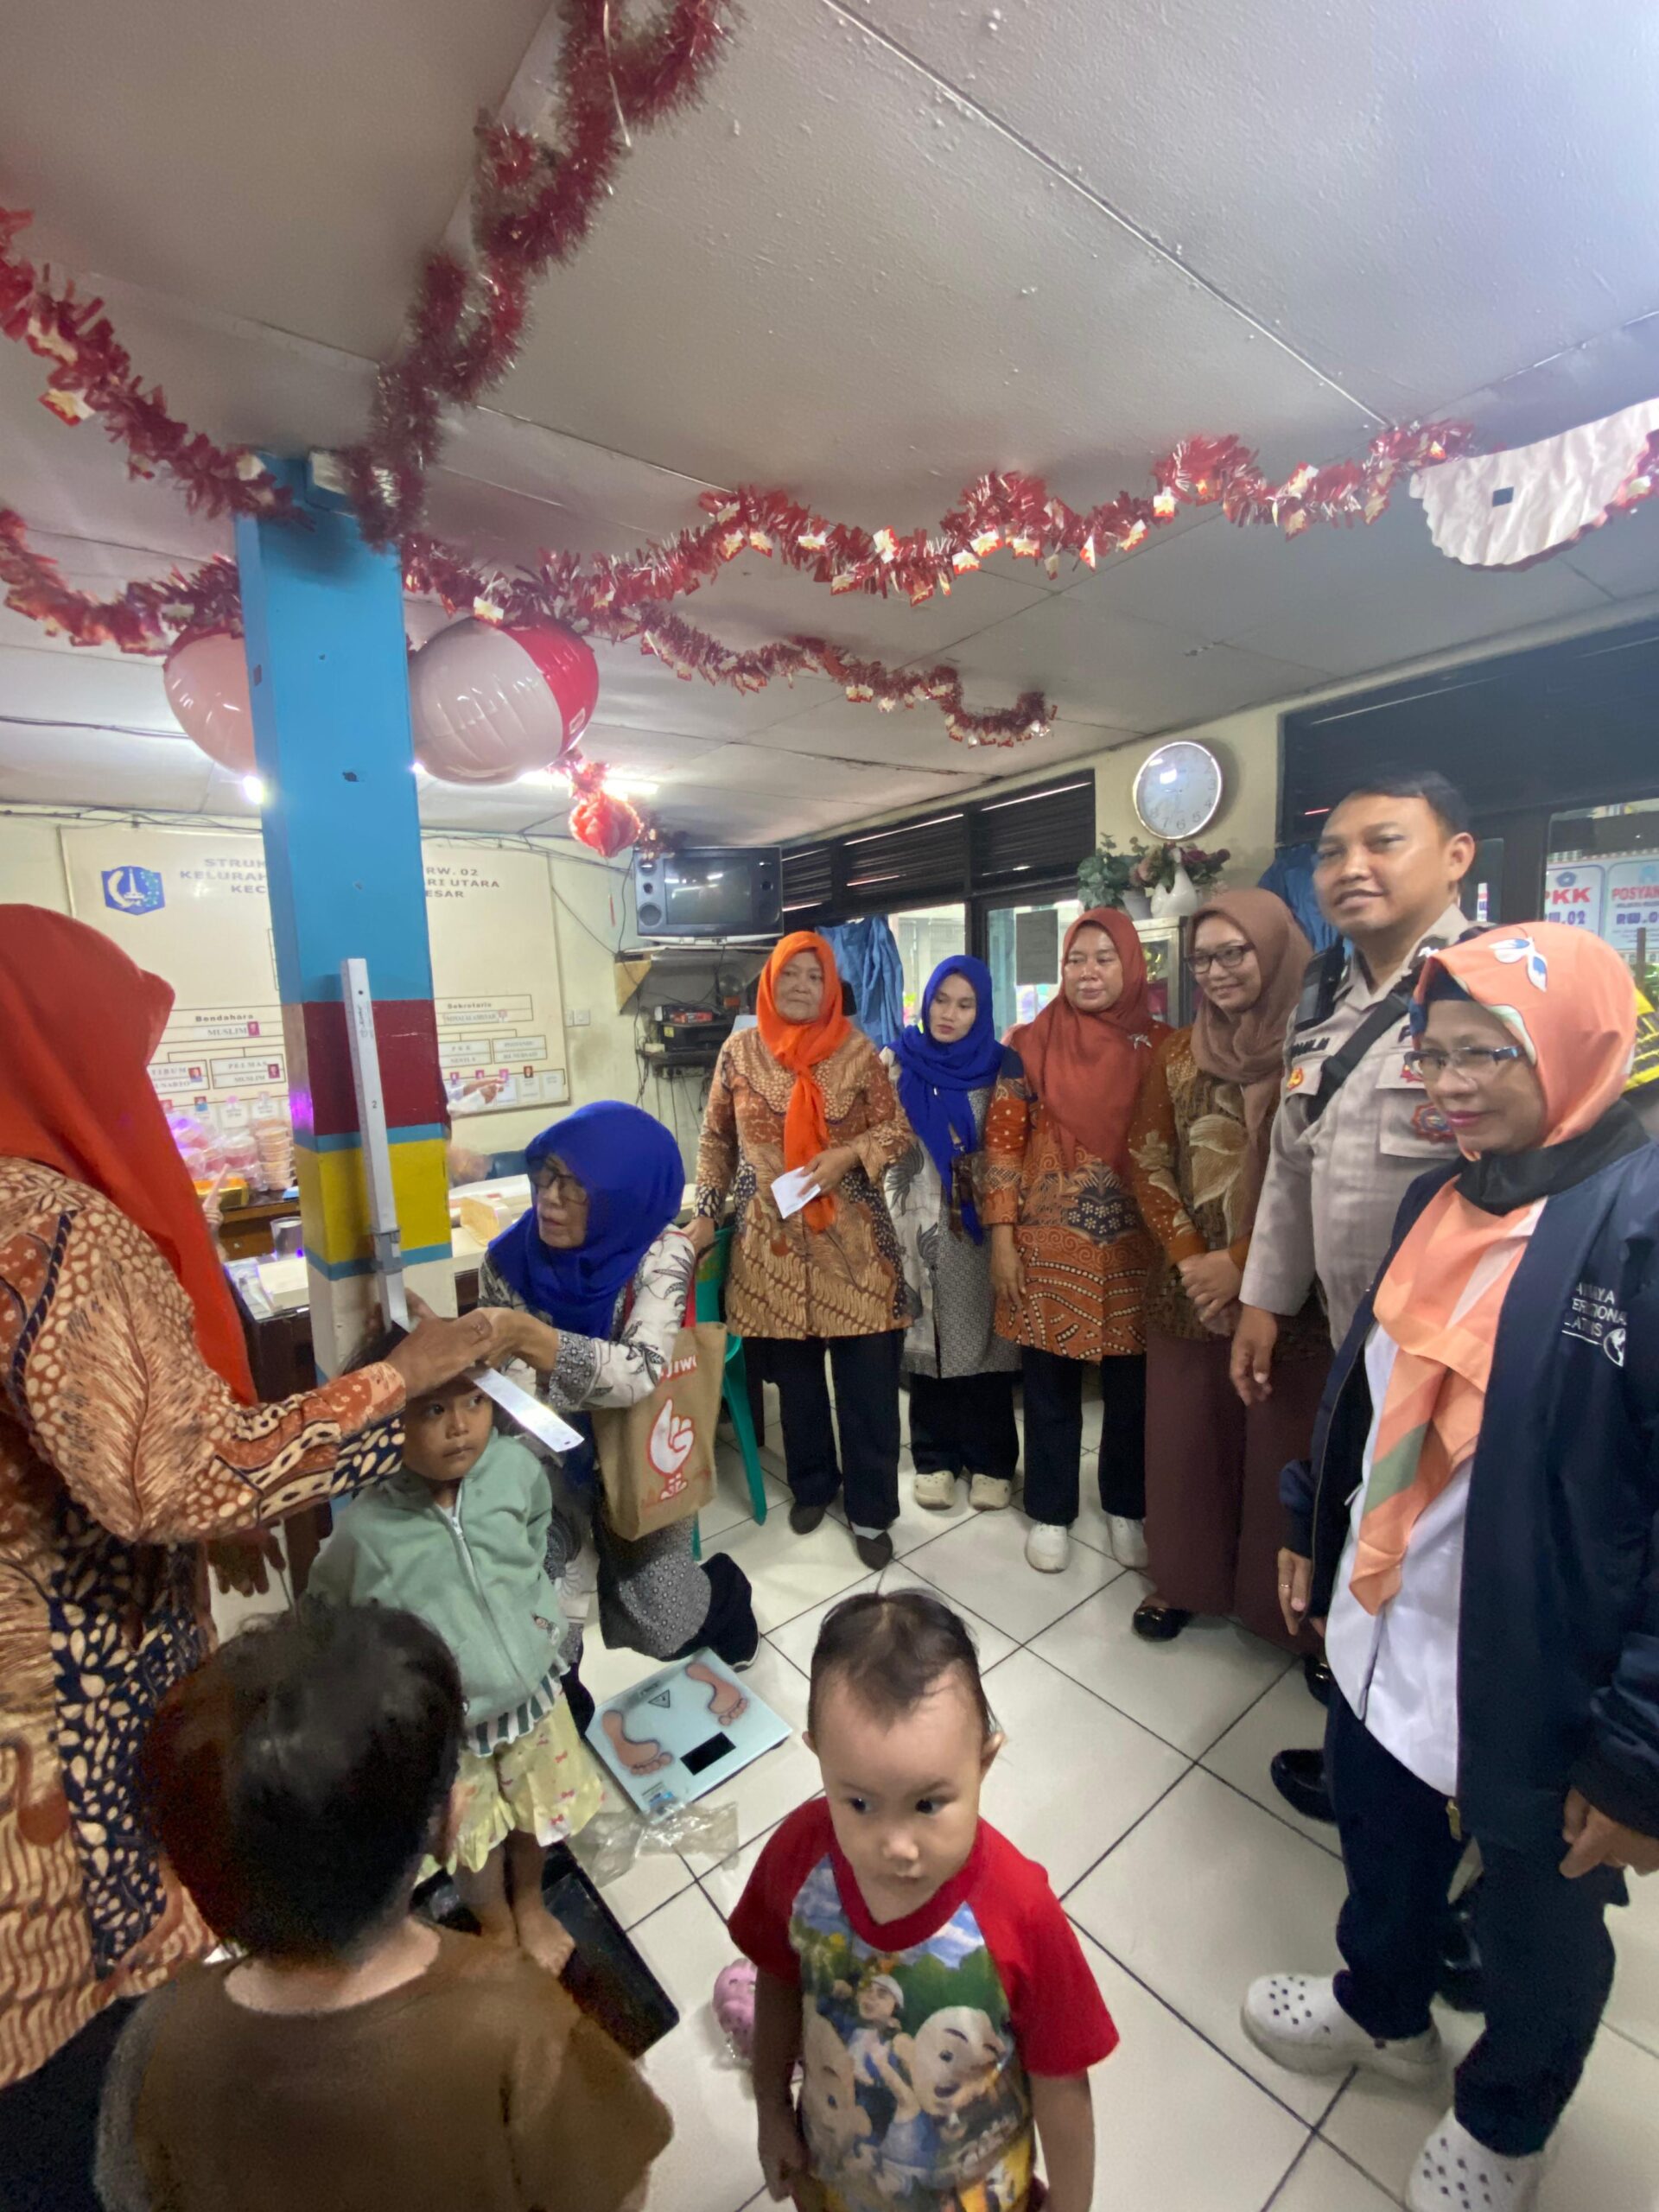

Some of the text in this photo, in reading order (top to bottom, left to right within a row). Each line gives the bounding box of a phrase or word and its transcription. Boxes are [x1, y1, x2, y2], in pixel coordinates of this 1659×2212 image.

[1161, 817, 1169, 829] 7
[1176, 818, 1186, 830] 6
[450, 880, 499, 888] UTARA
[207, 1027, 247, 1036] MUSLIM
[372, 1100, 378, 1109] 2
